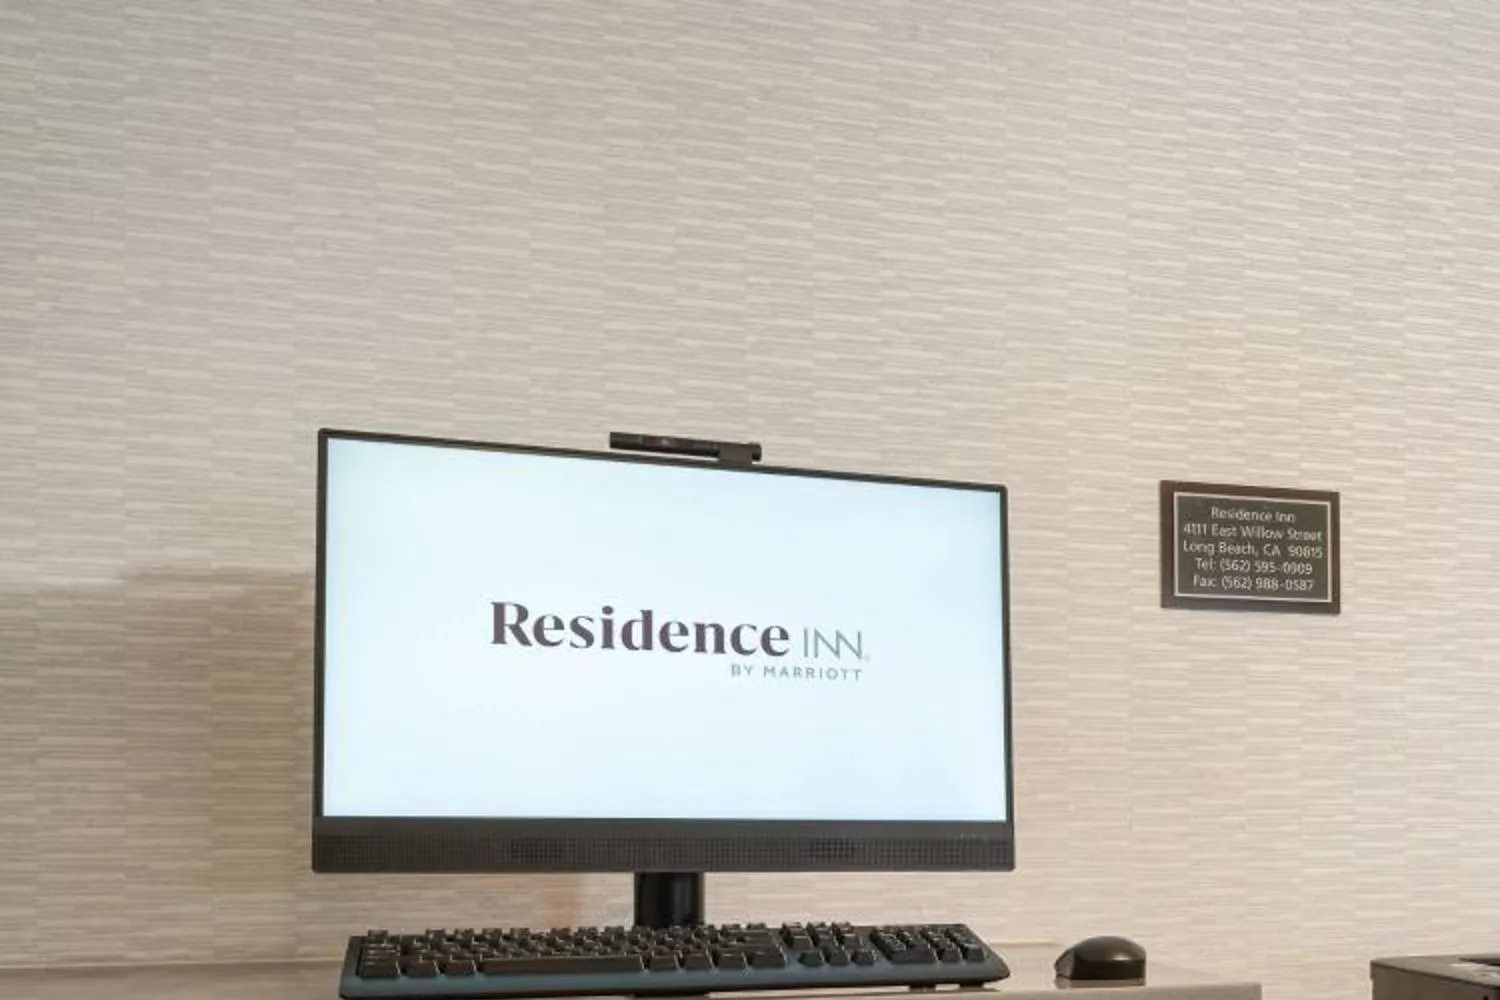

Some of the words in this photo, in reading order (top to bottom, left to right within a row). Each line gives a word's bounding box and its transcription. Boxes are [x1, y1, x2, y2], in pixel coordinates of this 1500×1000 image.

[1210, 506, 1273, 523] Residence
[1275, 510, 1296, 525] Inn
[1211, 523, 1237, 538] East
[1240, 524, 1283, 541] Willow
[1287, 527, 1323, 542] Street
[1183, 539, 1215, 558] Long
[1219, 541, 1259, 559] Beach,
[1263, 543, 1281, 558] CA
[1220, 557, 1250, 575] (562)
[1221, 575, 1252, 592] (562)
[489, 600, 791, 659] Residence
[803, 627, 863, 661] INN
[731, 663, 753, 678] BY
[763, 664, 863, 681] MARRIOTT
